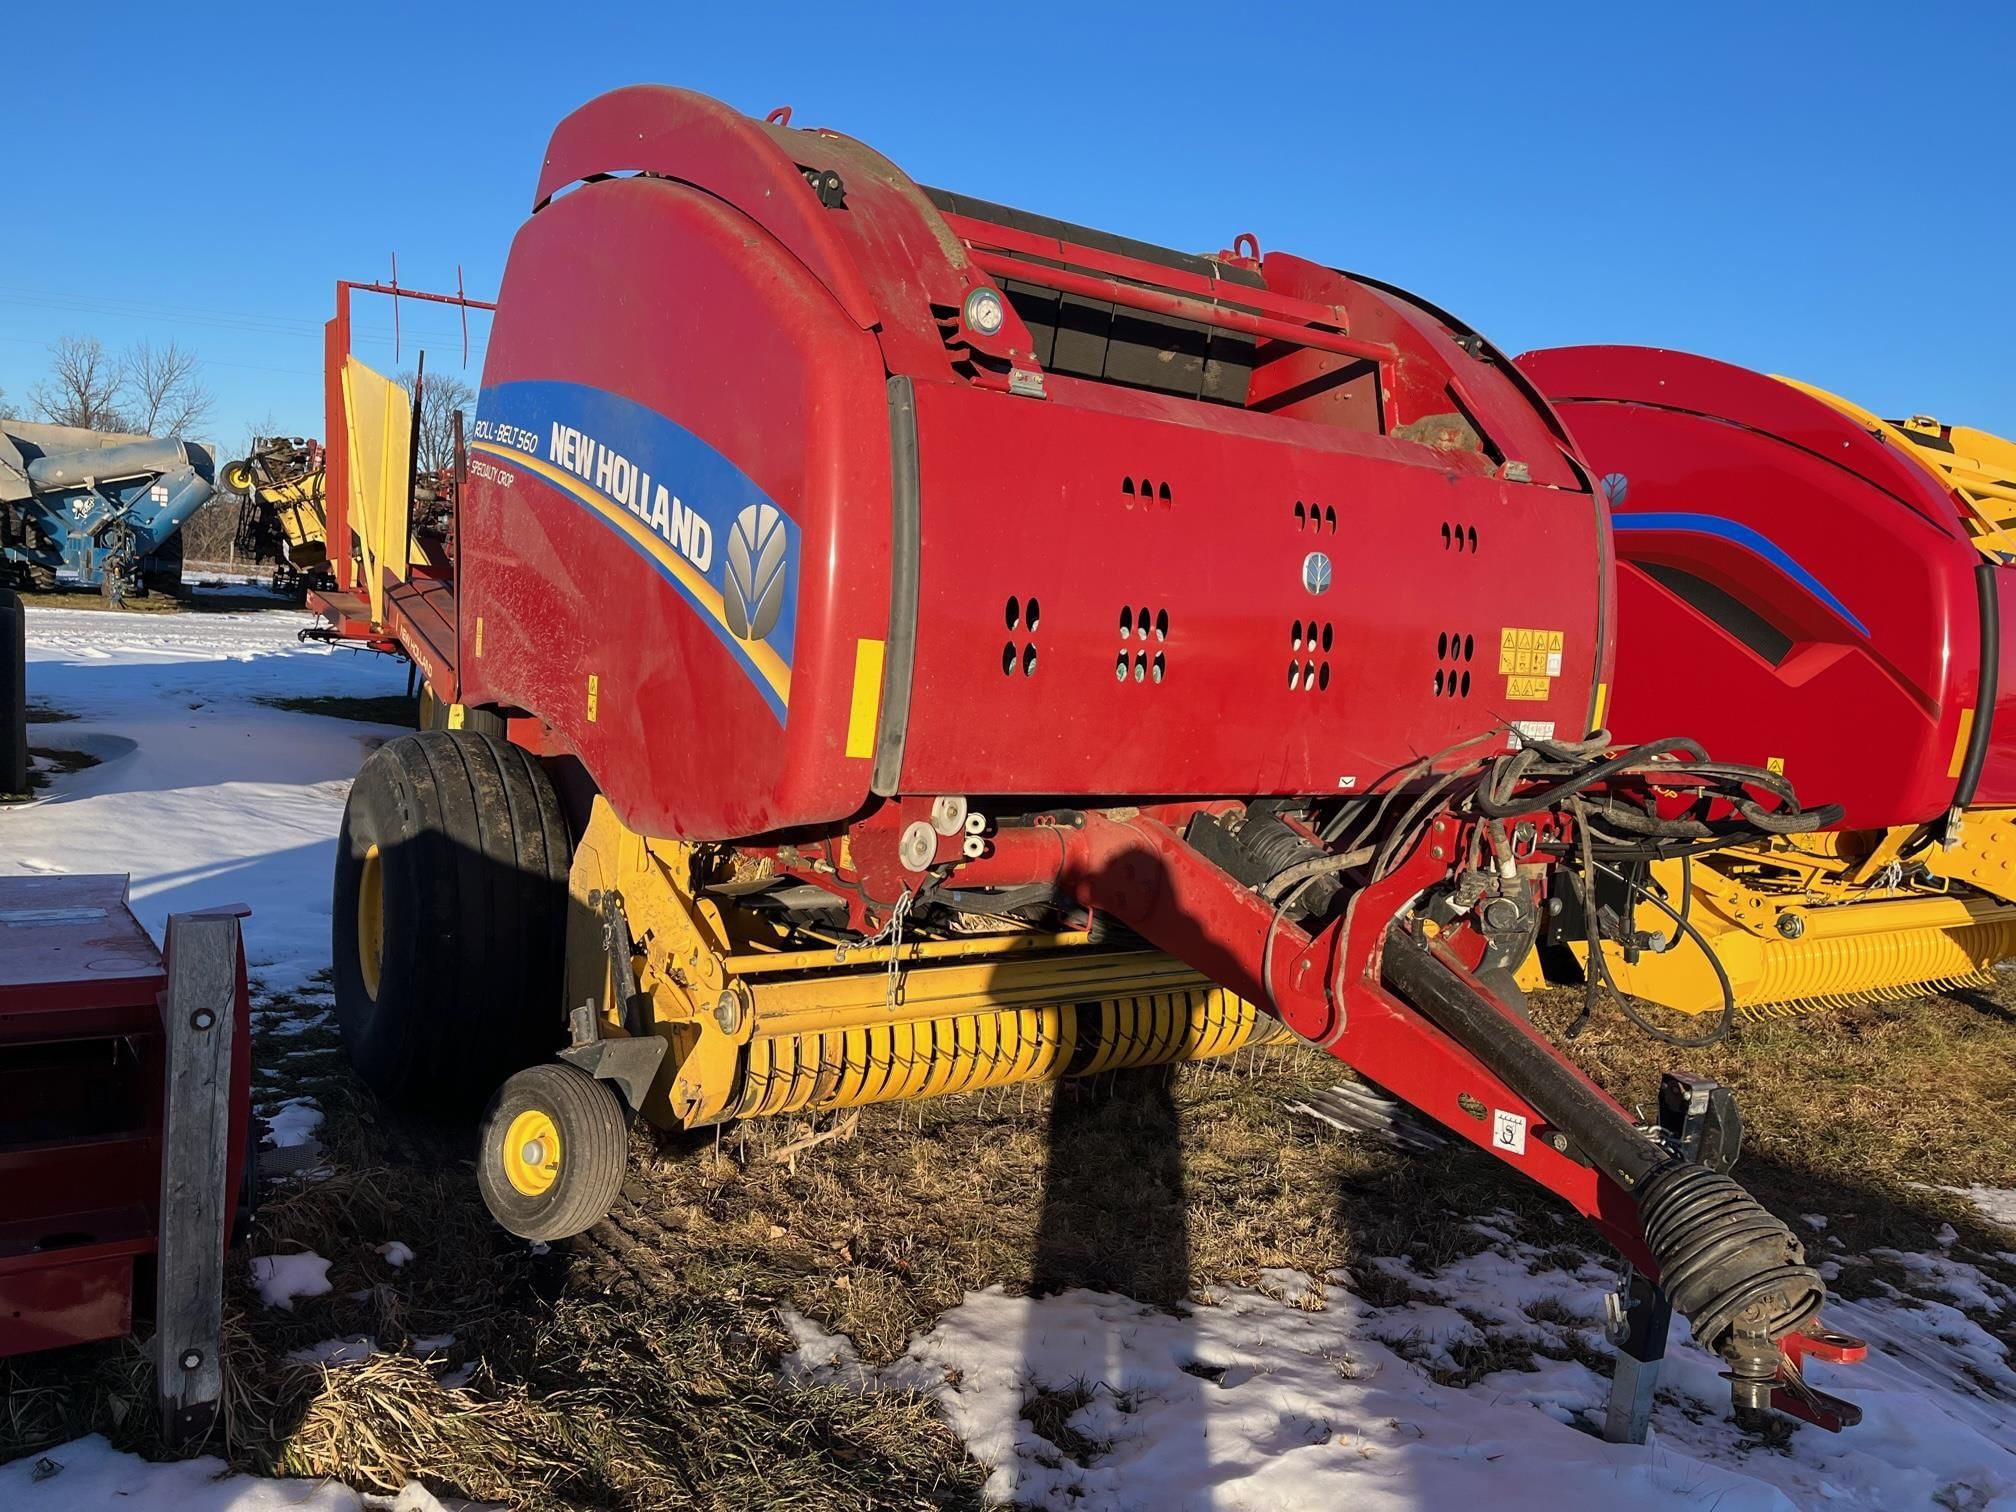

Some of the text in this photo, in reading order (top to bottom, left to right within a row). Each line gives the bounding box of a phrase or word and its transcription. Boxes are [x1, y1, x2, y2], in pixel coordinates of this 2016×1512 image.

[516, 429, 538, 453] 560
[471, 460, 515, 488] SPECIALTY CROP
[549, 421, 713, 573] NEW HOLLAND
